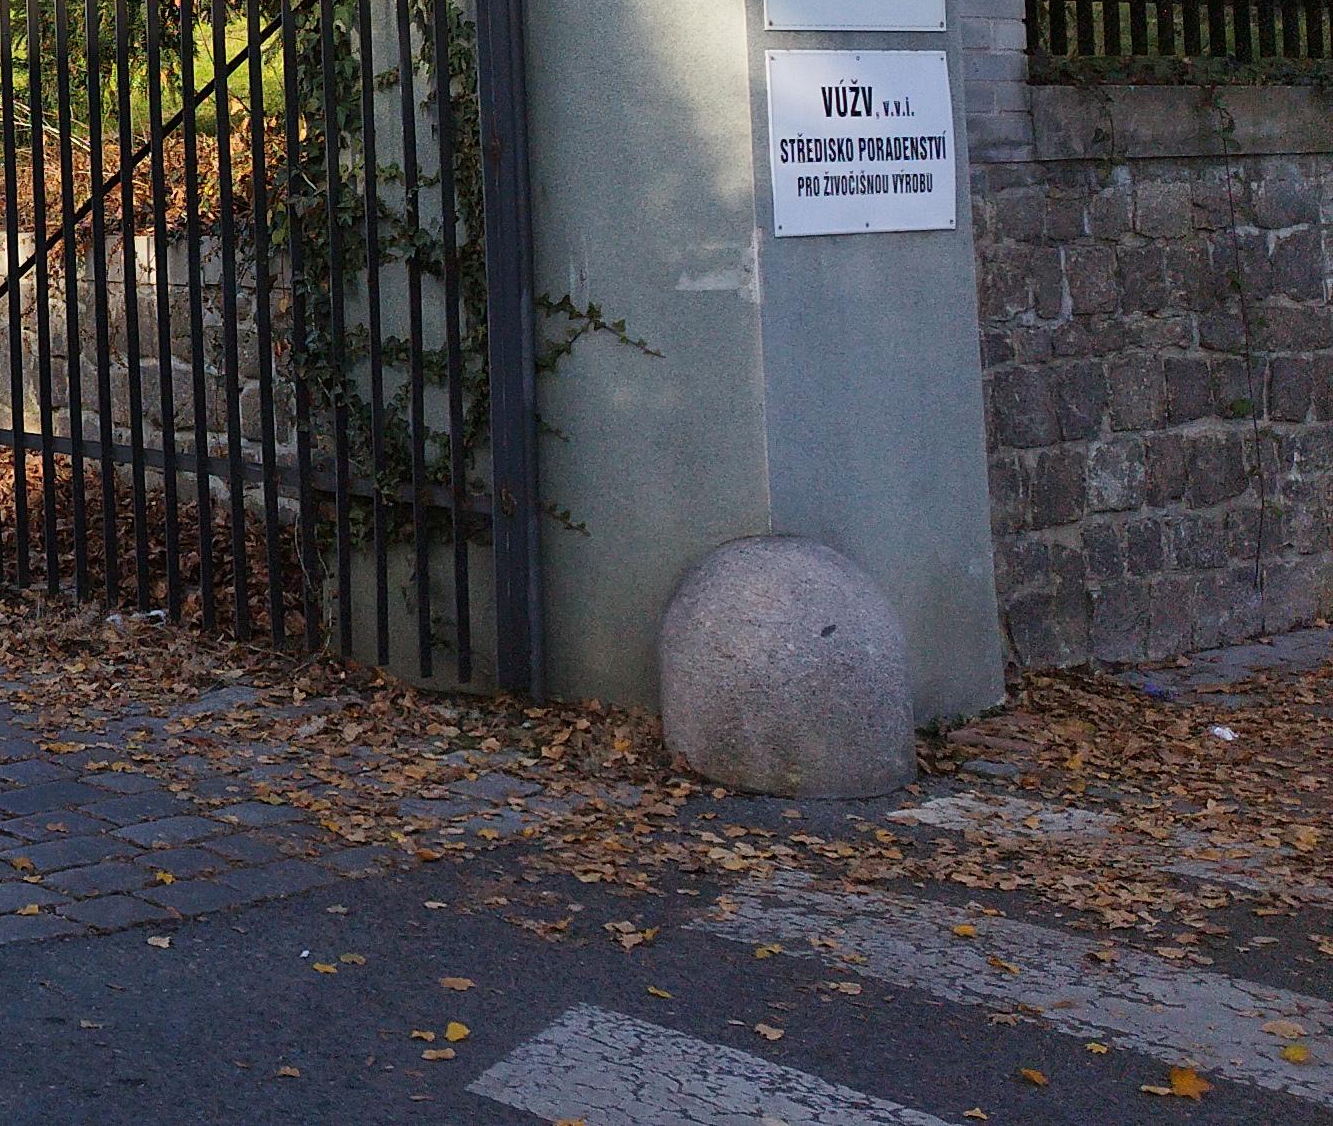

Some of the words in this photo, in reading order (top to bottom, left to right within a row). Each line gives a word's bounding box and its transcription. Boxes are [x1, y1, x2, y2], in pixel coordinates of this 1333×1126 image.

[821, 79, 880, 119] VÚŽV,
[883, 97, 915, 117] v.v.i.
[780, 133, 854, 163] STŘEDISKO
[858, 131, 946, 161] PORADENSTVÍ
[797, 175, 820, 197] PRO
[823, 171, 889, 196] ŽIVOČIŠNOU
[892, 169, 933, 194] VÝROBU
